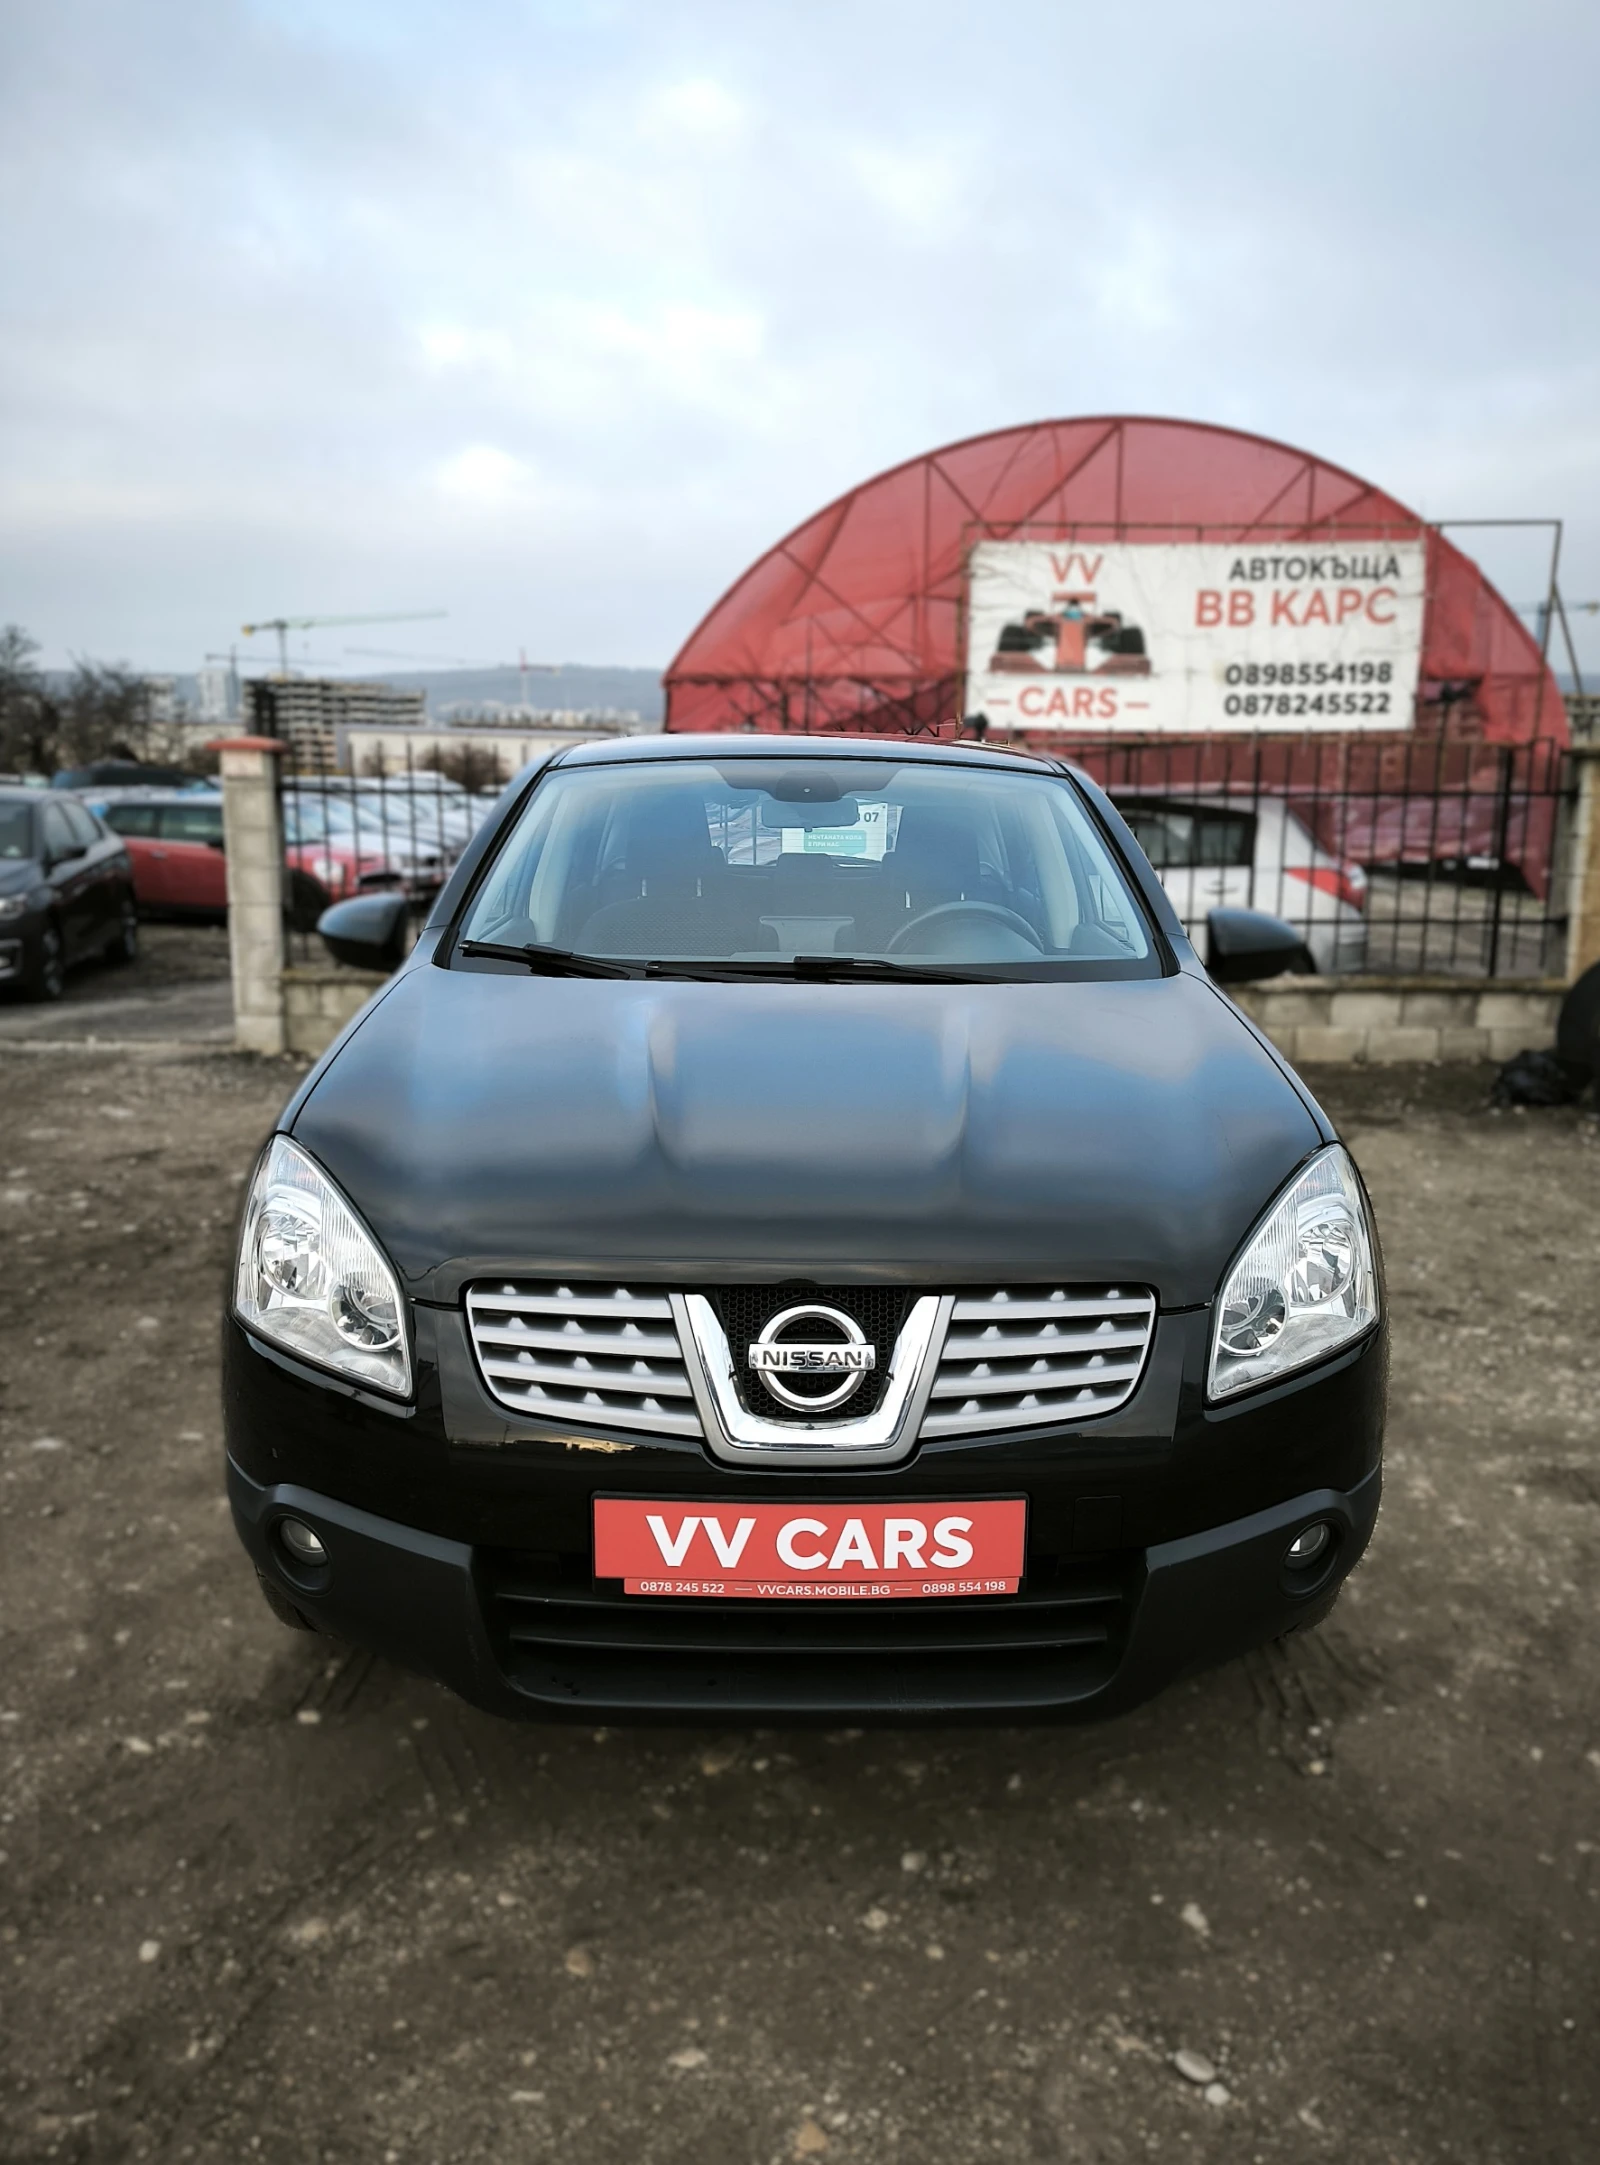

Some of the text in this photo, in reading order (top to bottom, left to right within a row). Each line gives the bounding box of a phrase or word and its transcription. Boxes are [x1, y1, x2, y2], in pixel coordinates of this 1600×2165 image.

[1050, 553, 1103, 584] VV
[1229, 555, 1401, 583] АВТОКЪЩА
[1195, 587, 1398, 627] ВВ КАРС
[1225, 662, 1392, 686] 0898554198
[1018, 687, 1118, 718] CARS
[1224, 692, 1391, 716] 0878245522
[864, 812, 879, 822] 07
[762, 1350, 862, 1367] NISSAN
[645, 1515, 975, 1570] VV CARS
[640, 1581, 1006, 1596] 0878 245 522 VVCARS.MOBILE.BG 0898 554 198
